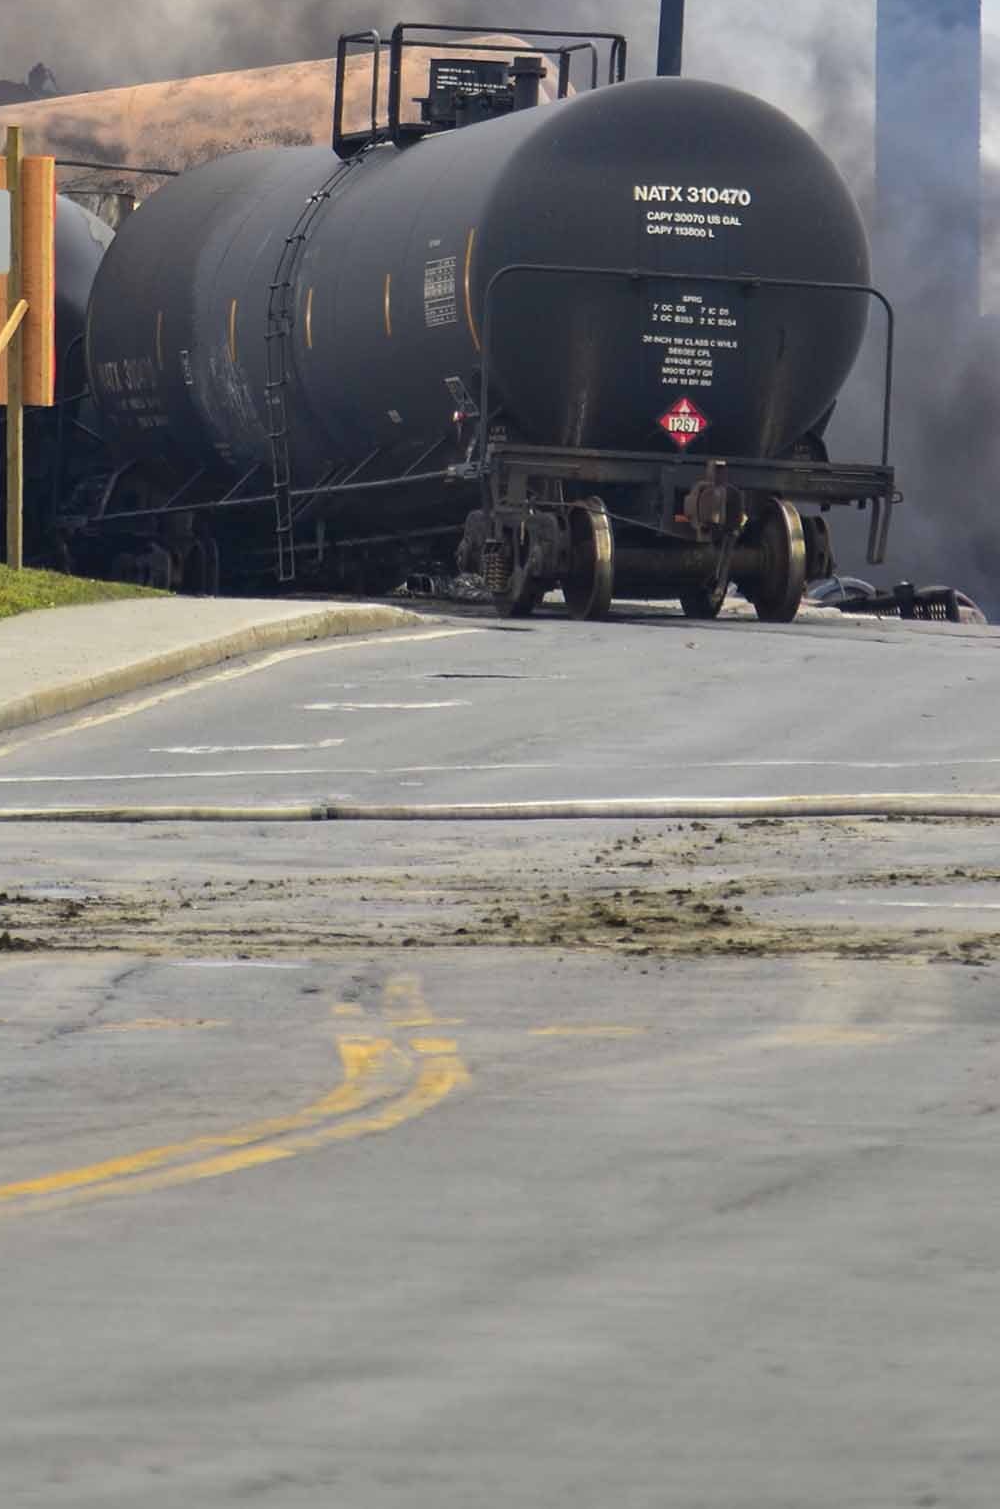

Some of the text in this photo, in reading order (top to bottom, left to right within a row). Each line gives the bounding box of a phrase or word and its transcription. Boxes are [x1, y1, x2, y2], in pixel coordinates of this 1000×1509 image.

[633, 185, 751, 206] NATX 310470
[646, 211, 742, 227] CAPY 30070 US GAL
[646, 225, 673, 235] CAPY
[708, 229, 715, 238] L
[684, 338, 709, 347] CLASS
[671, 418, 697, 432] 1267
